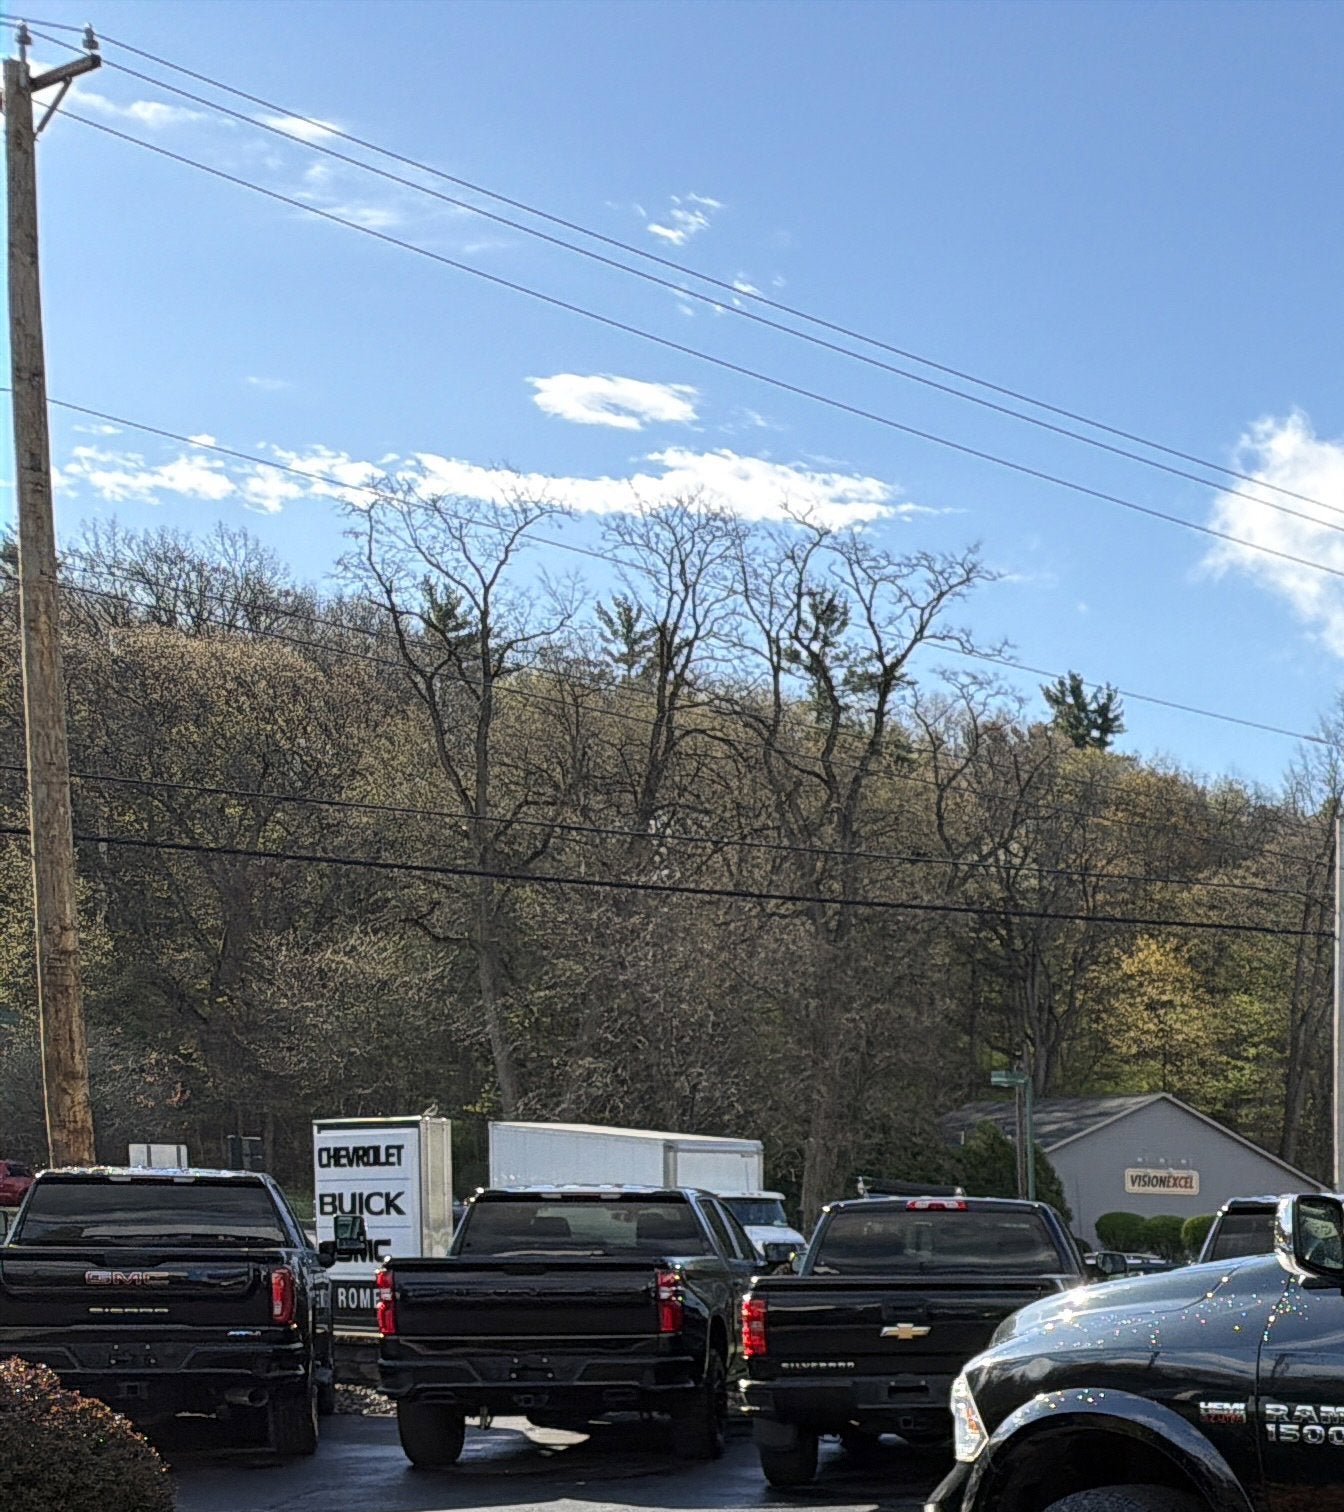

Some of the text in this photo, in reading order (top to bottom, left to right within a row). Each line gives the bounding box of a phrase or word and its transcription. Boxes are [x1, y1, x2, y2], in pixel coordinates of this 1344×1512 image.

[318, 1145, 405, 1168] CHEVROLET
[1130, 1175, 1194, 1189] VISIONEXCEL
[318, 1191, 406, 1216] BUICK
[85, 1271, 169, 1285] GMC
